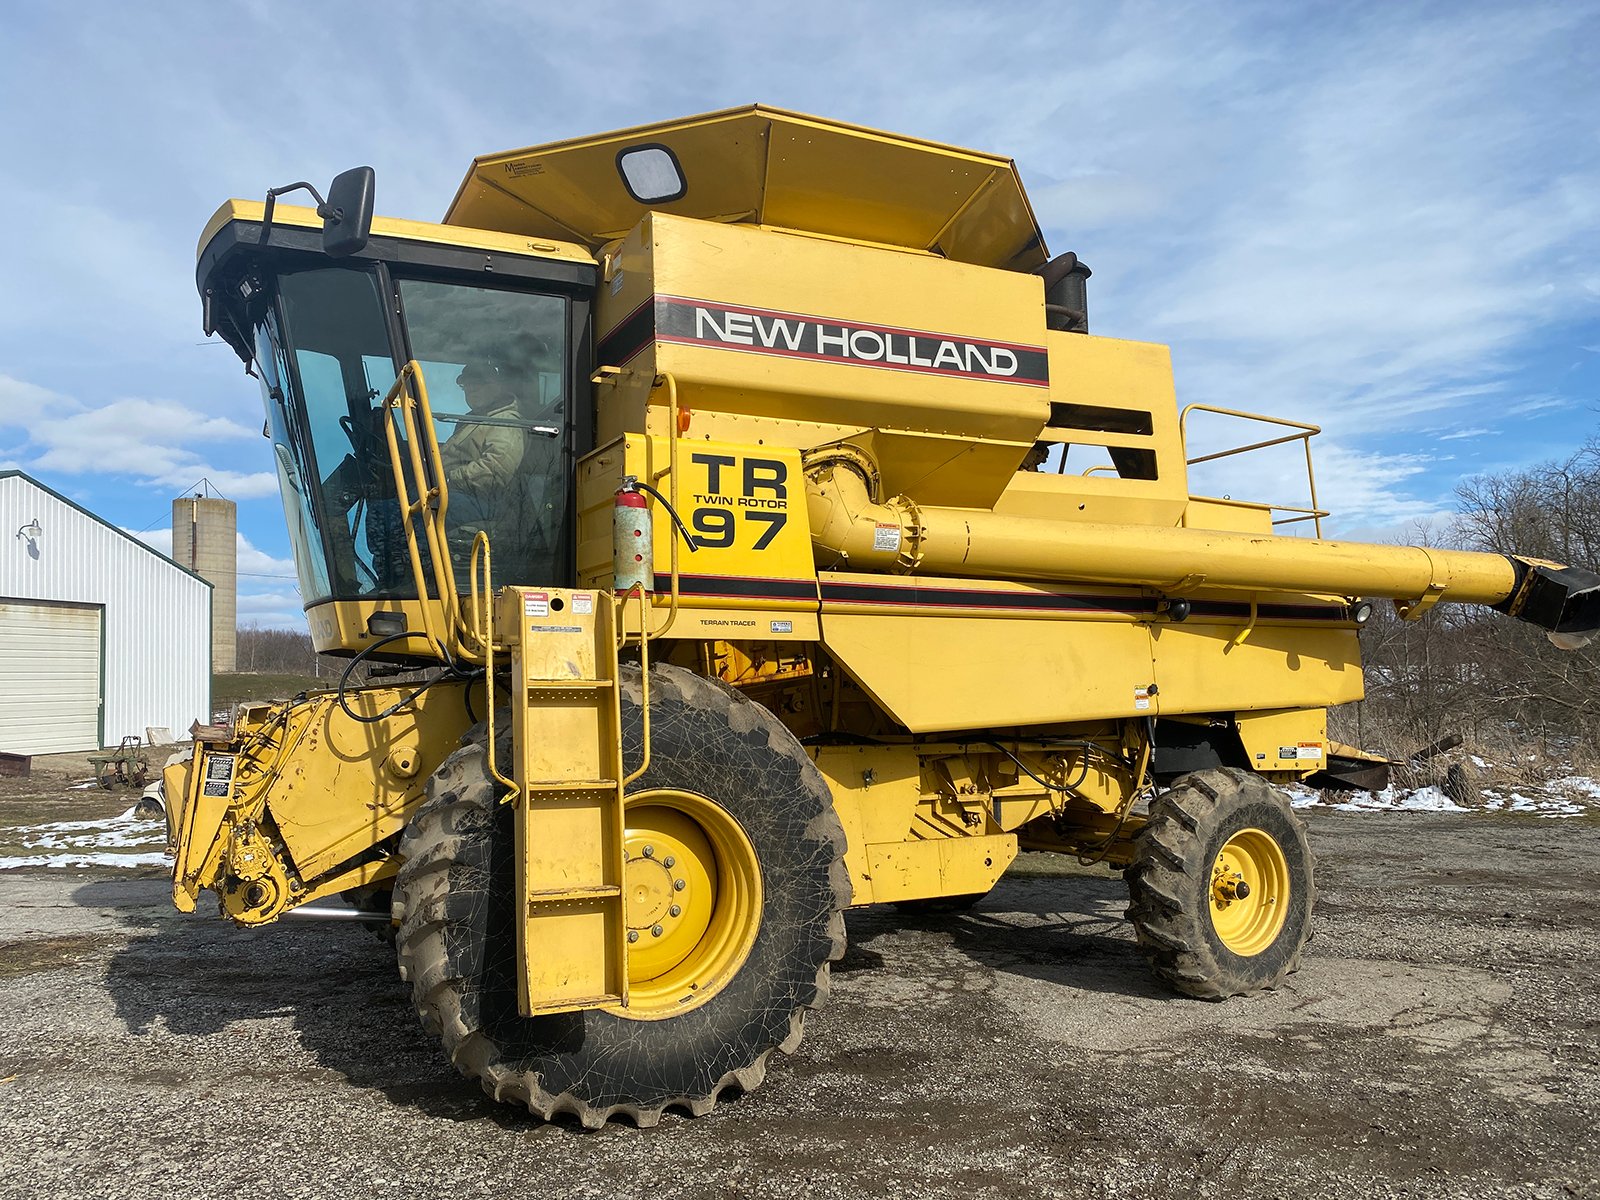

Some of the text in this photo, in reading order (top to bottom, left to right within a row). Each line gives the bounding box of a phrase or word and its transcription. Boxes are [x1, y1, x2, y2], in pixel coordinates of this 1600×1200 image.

[695, 307, 1018, 377] NEW HOLLAND
[692, 454, 787, 499] TR
[693, 495, 787, 509] TWIN ROTOR
[692, 508, 787, 551] 97
